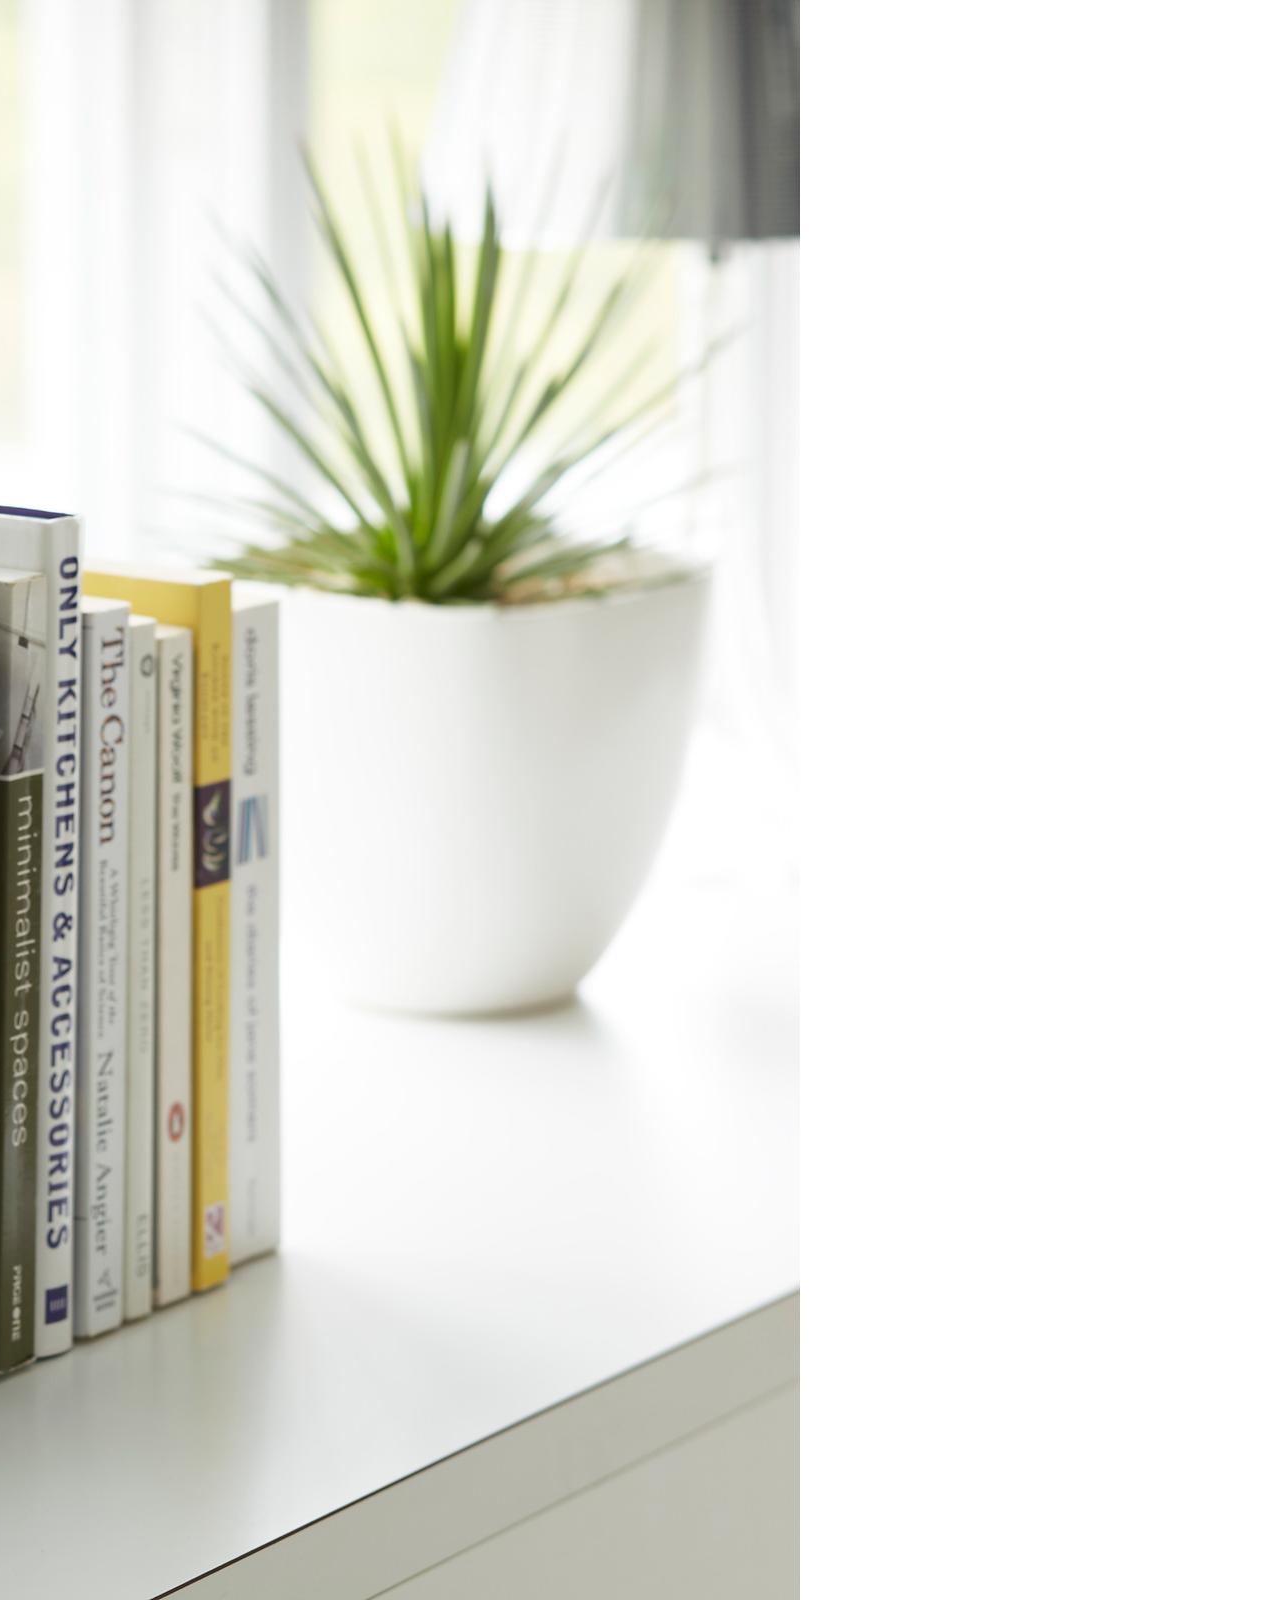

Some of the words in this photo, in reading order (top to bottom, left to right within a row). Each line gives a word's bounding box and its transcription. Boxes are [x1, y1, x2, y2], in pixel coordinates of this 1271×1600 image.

[58, 556, 79, 659] ONLY
[100, 625, 125, 709] The
[54, 678, 77, 897] KITCHENS
[98, 713, 126, 846] Canon
[14, 794, 38, 998] minimalist
[53, 911, 73, 942] &
[10, 1009, 31, 1148] spaces
[47, 955, 73, 1249] ACCESSORIES
[95, 1051, 114, 1153] Natalie
[91, 1162, 113, 1257] Angier
